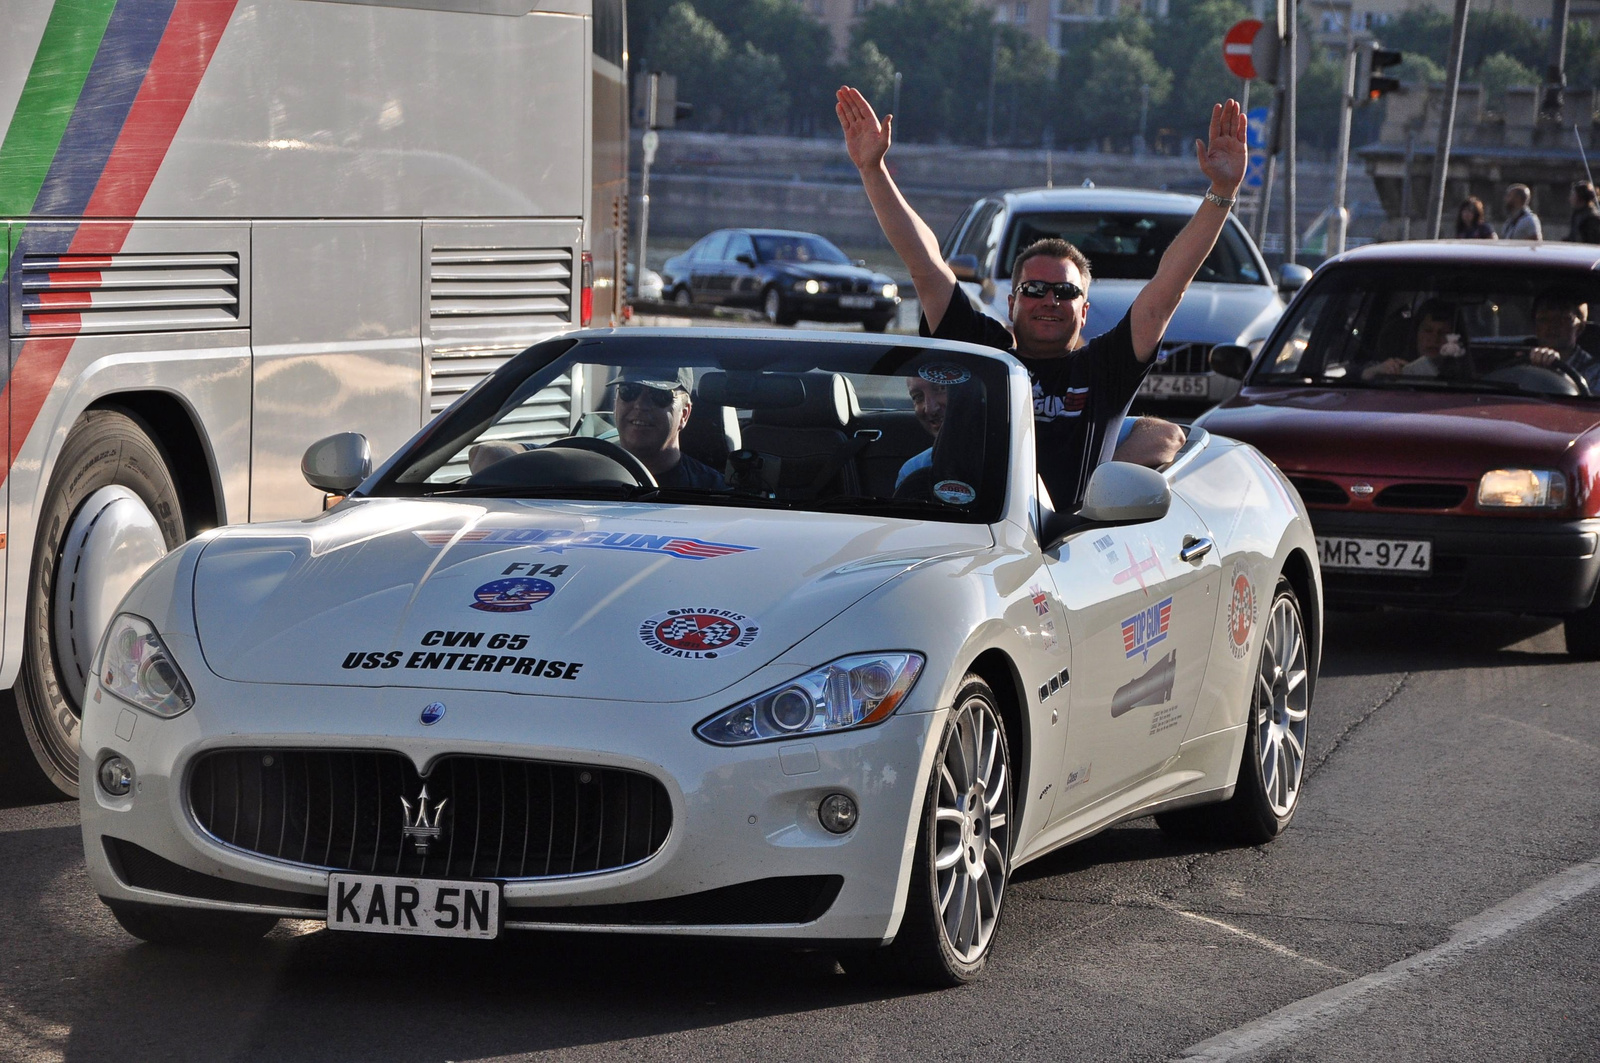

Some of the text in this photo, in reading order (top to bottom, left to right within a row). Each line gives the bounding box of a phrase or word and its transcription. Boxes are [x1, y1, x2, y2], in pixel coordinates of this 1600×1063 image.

[484, 528, 668, 550] TOP GUN
[1315, 539, 1427, 568] MR-974
[501, 562, 569, 577] F14
[38, 514, 79, 738] DUNLOP
[680, 607, 746, 621] MORRIS
[1133, 603, 1161, 647] TOP GUN
[420, 630, 530, 650] CVN 65
[639, 619, 704, 659] CANNONBALL
[734, 630, 758, 648] RUN
[341, 651, 583, 680] USS ENTERPRISE
[335, 882, 490, 931] KAR 5N
